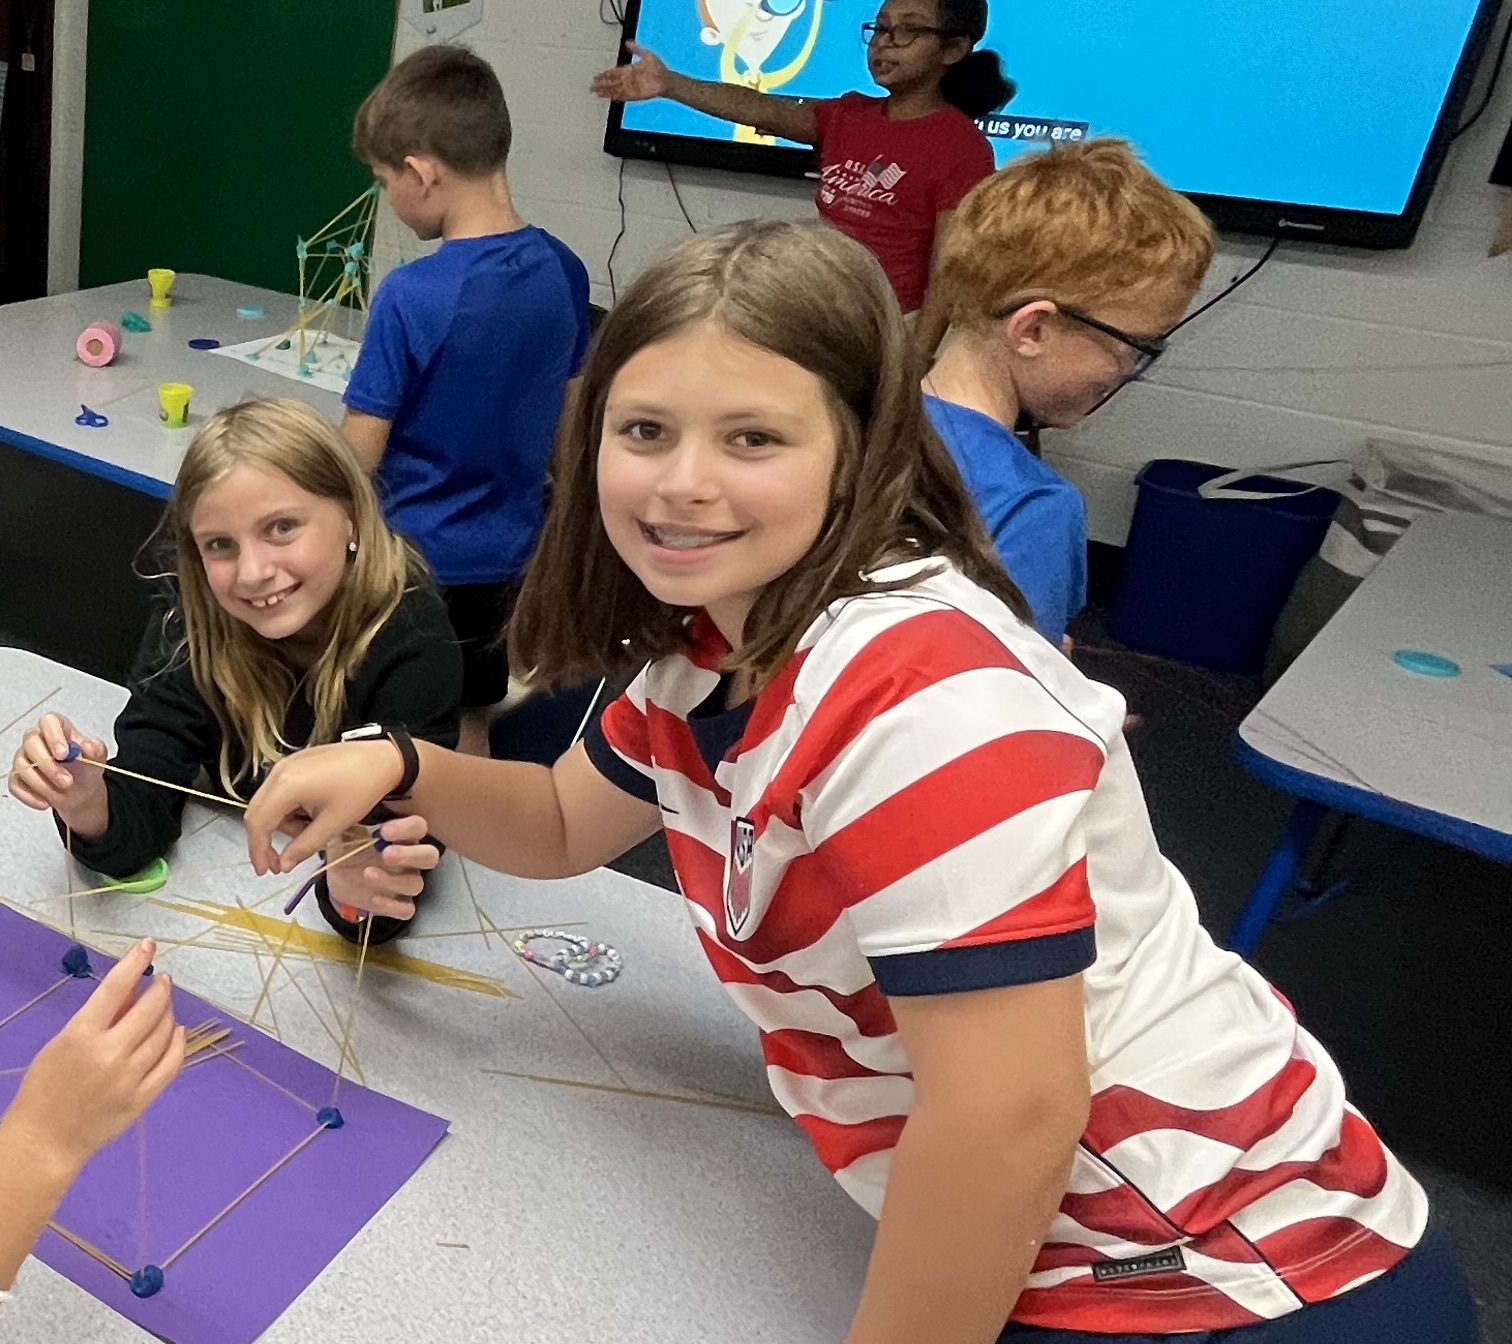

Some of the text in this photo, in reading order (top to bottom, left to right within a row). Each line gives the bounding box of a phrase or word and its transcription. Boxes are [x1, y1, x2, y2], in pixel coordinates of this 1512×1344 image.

[988, 120, 1010, 135] us
[1013, 122, 1048, 140] you
[1051, 126, 1082, 142] are
